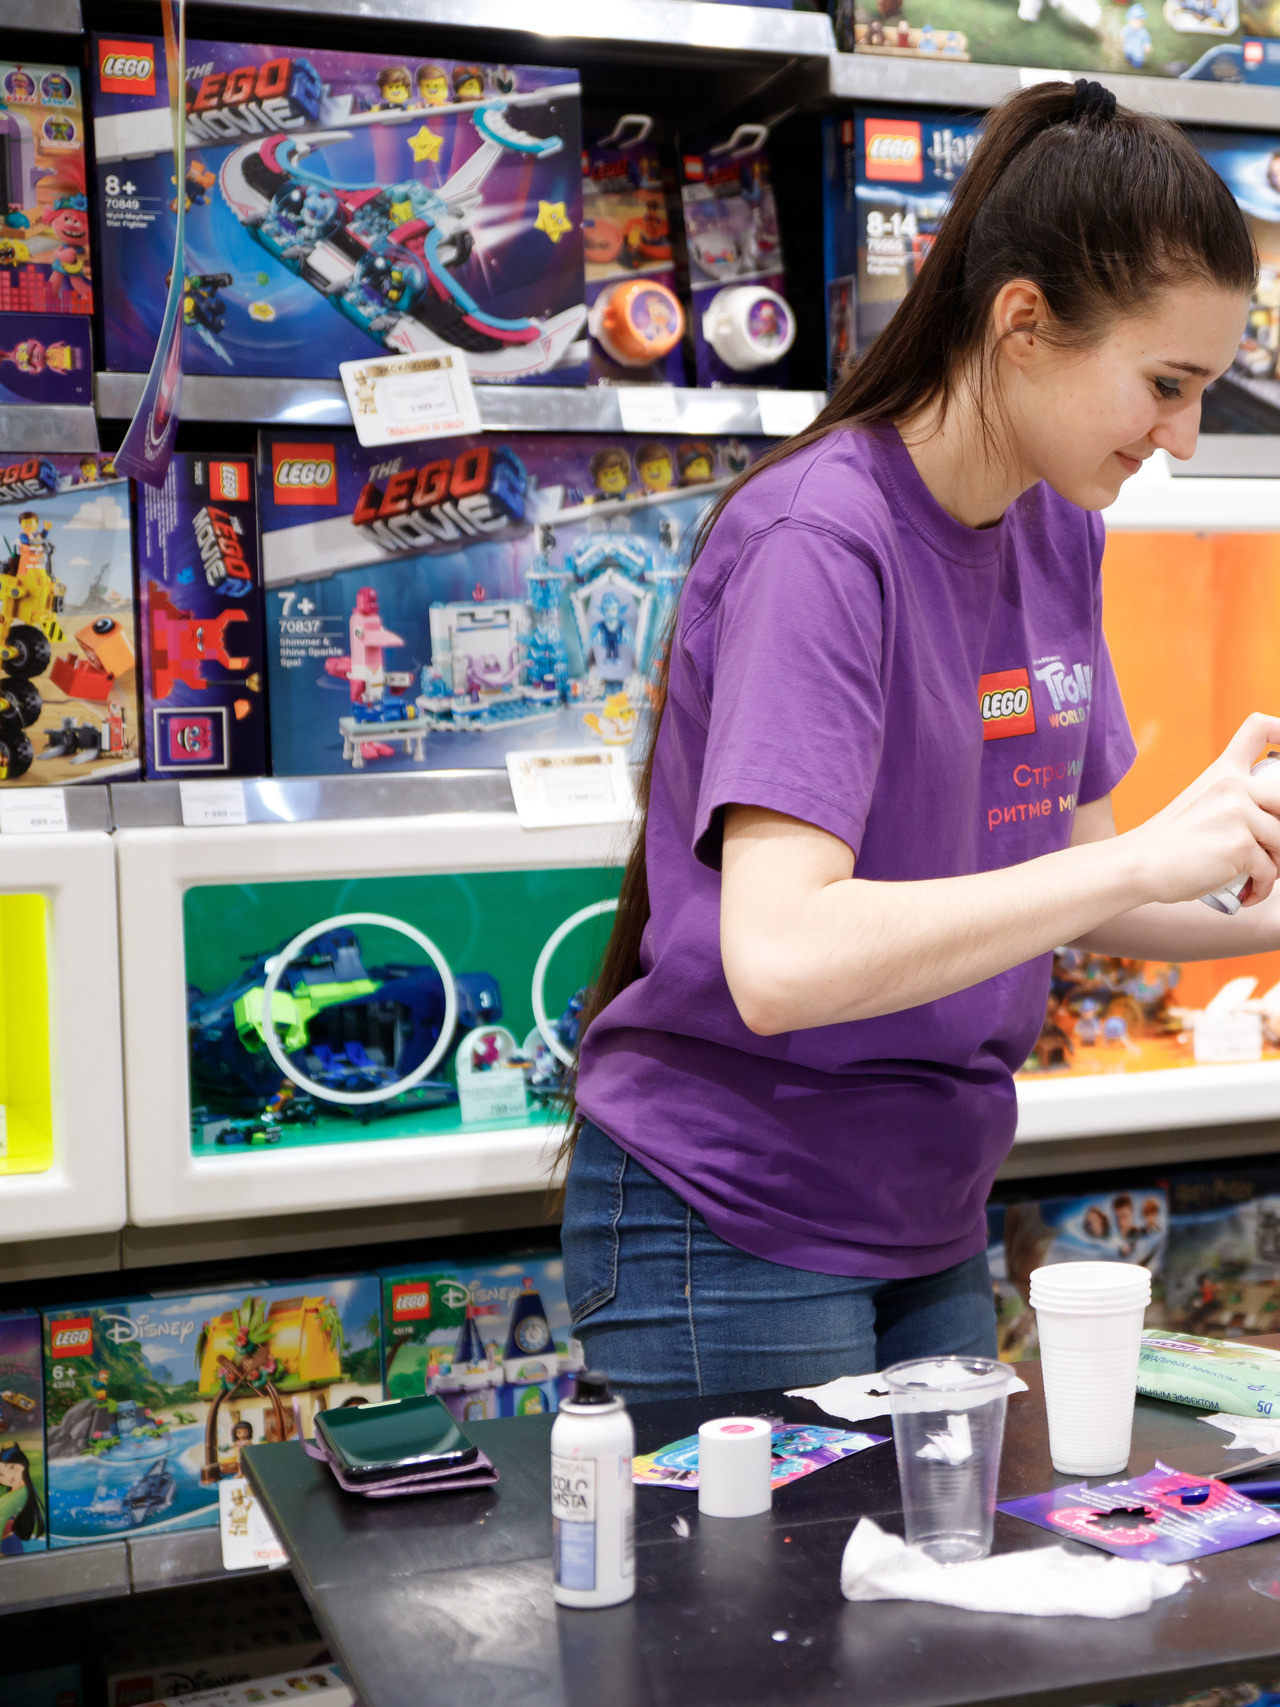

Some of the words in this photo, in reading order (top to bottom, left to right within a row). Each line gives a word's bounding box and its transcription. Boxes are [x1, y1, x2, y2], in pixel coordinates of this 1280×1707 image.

[102, 55, 152, 79] LEGO
[185, 61, 214, 81] THE
[870, 138, 918, 160] LEGO
[105, 175, 137, 195] 8+
[105, 199, 140, 210] 70849
[867, 211, 918, 237] 8-14
[221, 464, 238, 498] LEGO
[277, 462, 331, 486] LEGO
[368, 458, 402, 482] THE
[353, 446, 490, 526] LEGO
[358, 493, 508, 550] MOVIE
[192, 506, 228, 587] MOVIE
[207, 506, 251, 579] LEGO
[278, 591, 314, 616] 7+
[279, 619, 320, 633] 70837
[280, 637, 321, 647] Shimmer
[280, 647, 305, 657] Shine
[308, 647, 342, 659] Sparkle
[981, 688, 1029, 719] LEGO
[1048, 707, 1085, 728] WORLD
[988, 798, 1052, 831] ритме
[396, 1294, 427, 1310] LEGO
[55, 1329, 90, 1346] LEGO
[52, 1365, 77, 1379] 6+
[1172, 1393, 1219, 1410] ЭФФЕКТОМ
[1256, 1400, 1273, 1415] 50
